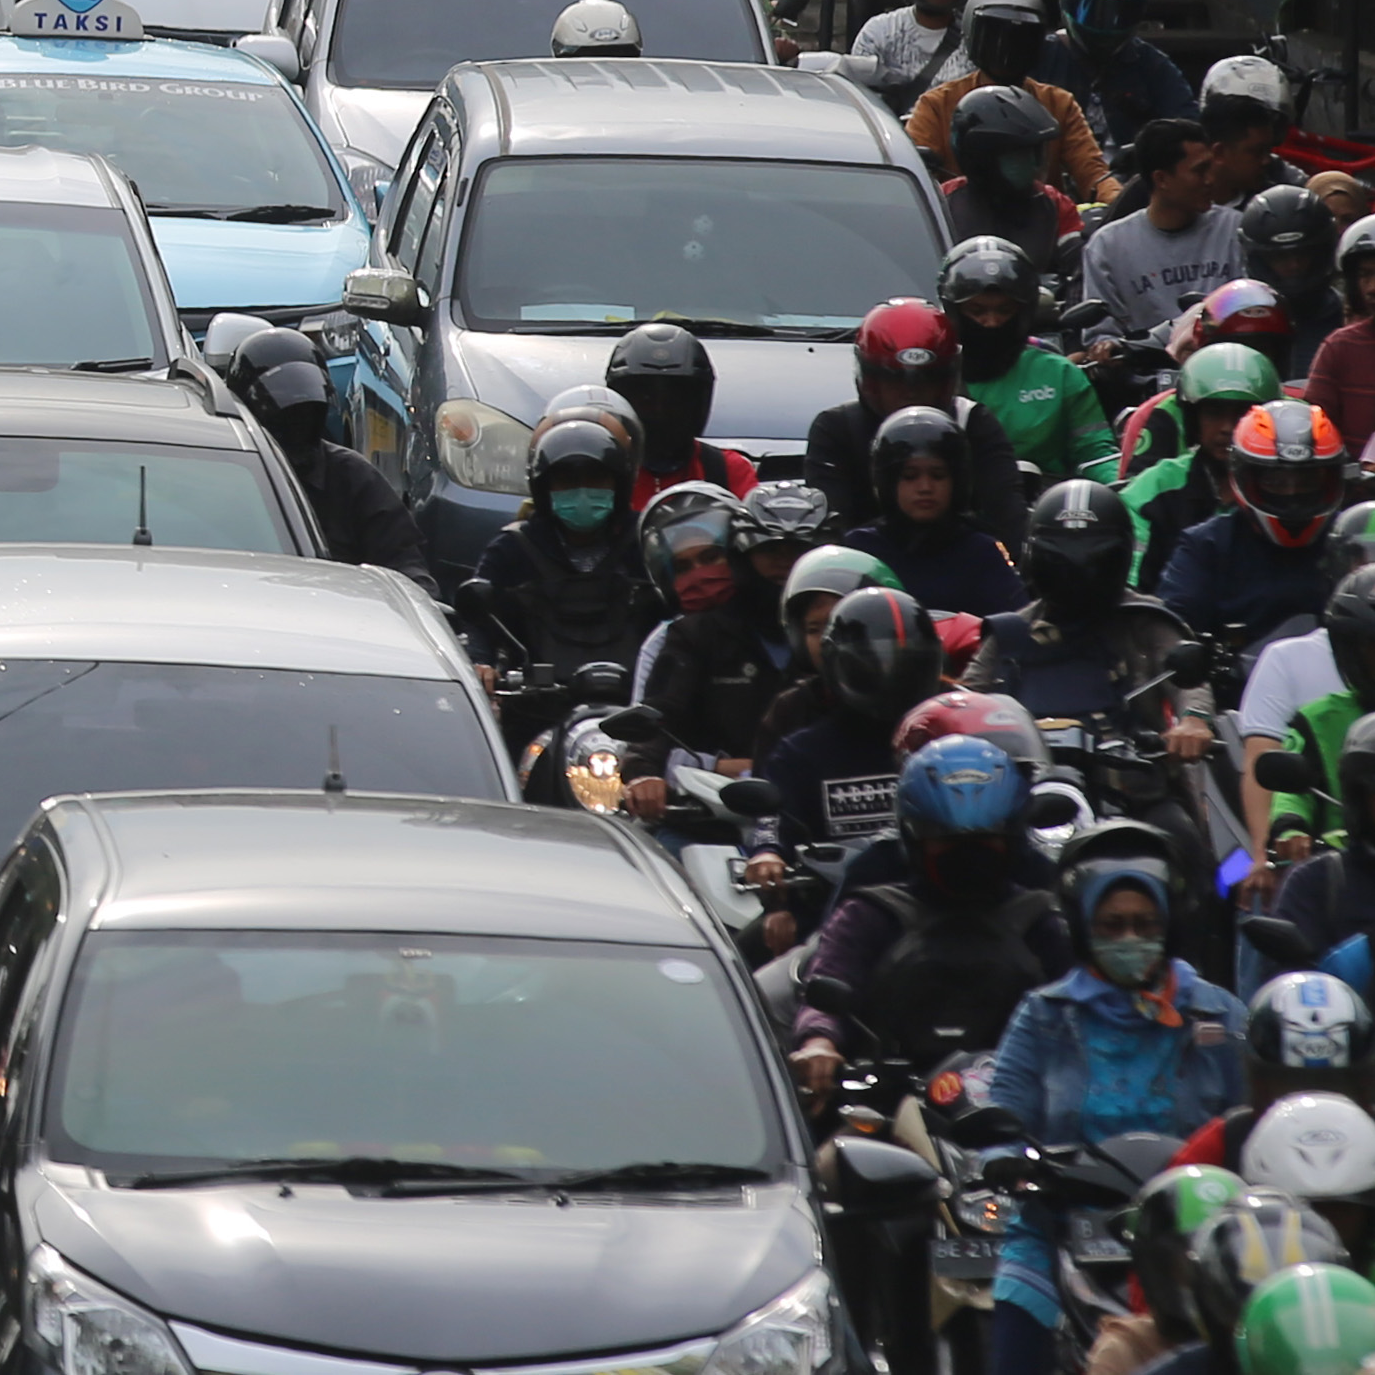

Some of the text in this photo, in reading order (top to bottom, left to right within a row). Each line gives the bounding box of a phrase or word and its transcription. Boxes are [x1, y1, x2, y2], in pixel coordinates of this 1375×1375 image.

[34, 12, 122, 33] TAKSI
[1130, 274, 1155, 295] LA
[1018, 385, 1056, 403] Grab
